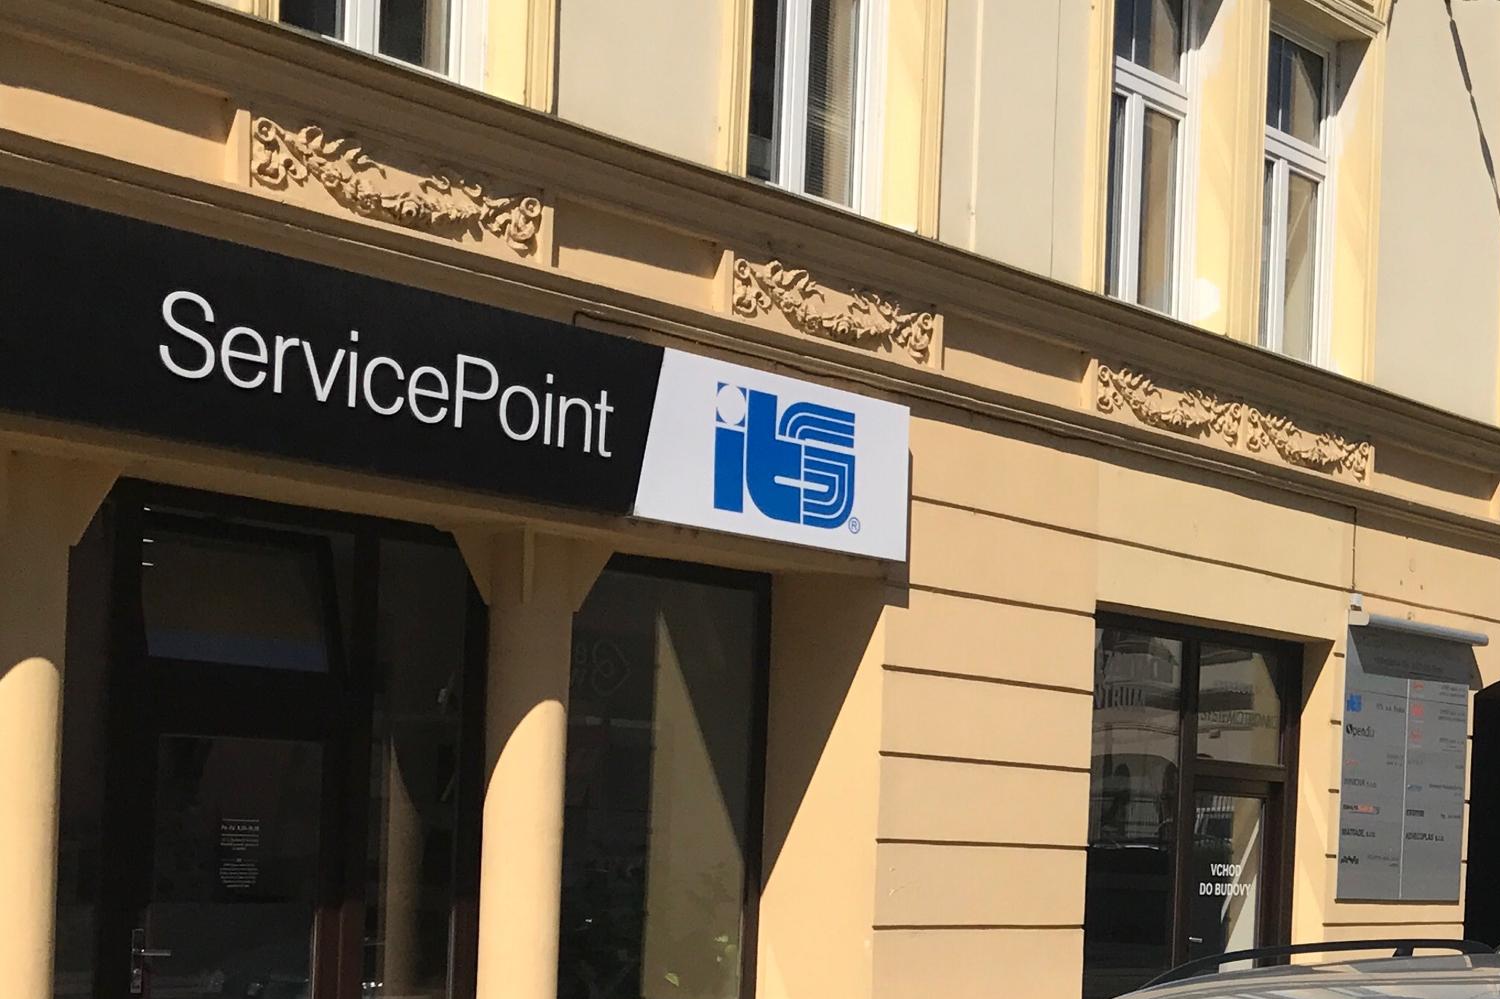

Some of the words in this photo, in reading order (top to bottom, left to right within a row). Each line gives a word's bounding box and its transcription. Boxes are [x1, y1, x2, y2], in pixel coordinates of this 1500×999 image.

[159, 290, 614, 458] ServicePoint
[1210, 863, 1242, 877] VCHOD
[1199, 882, 1213, 896] DO
[1214, 883, 1251, 897] BUDOVY
